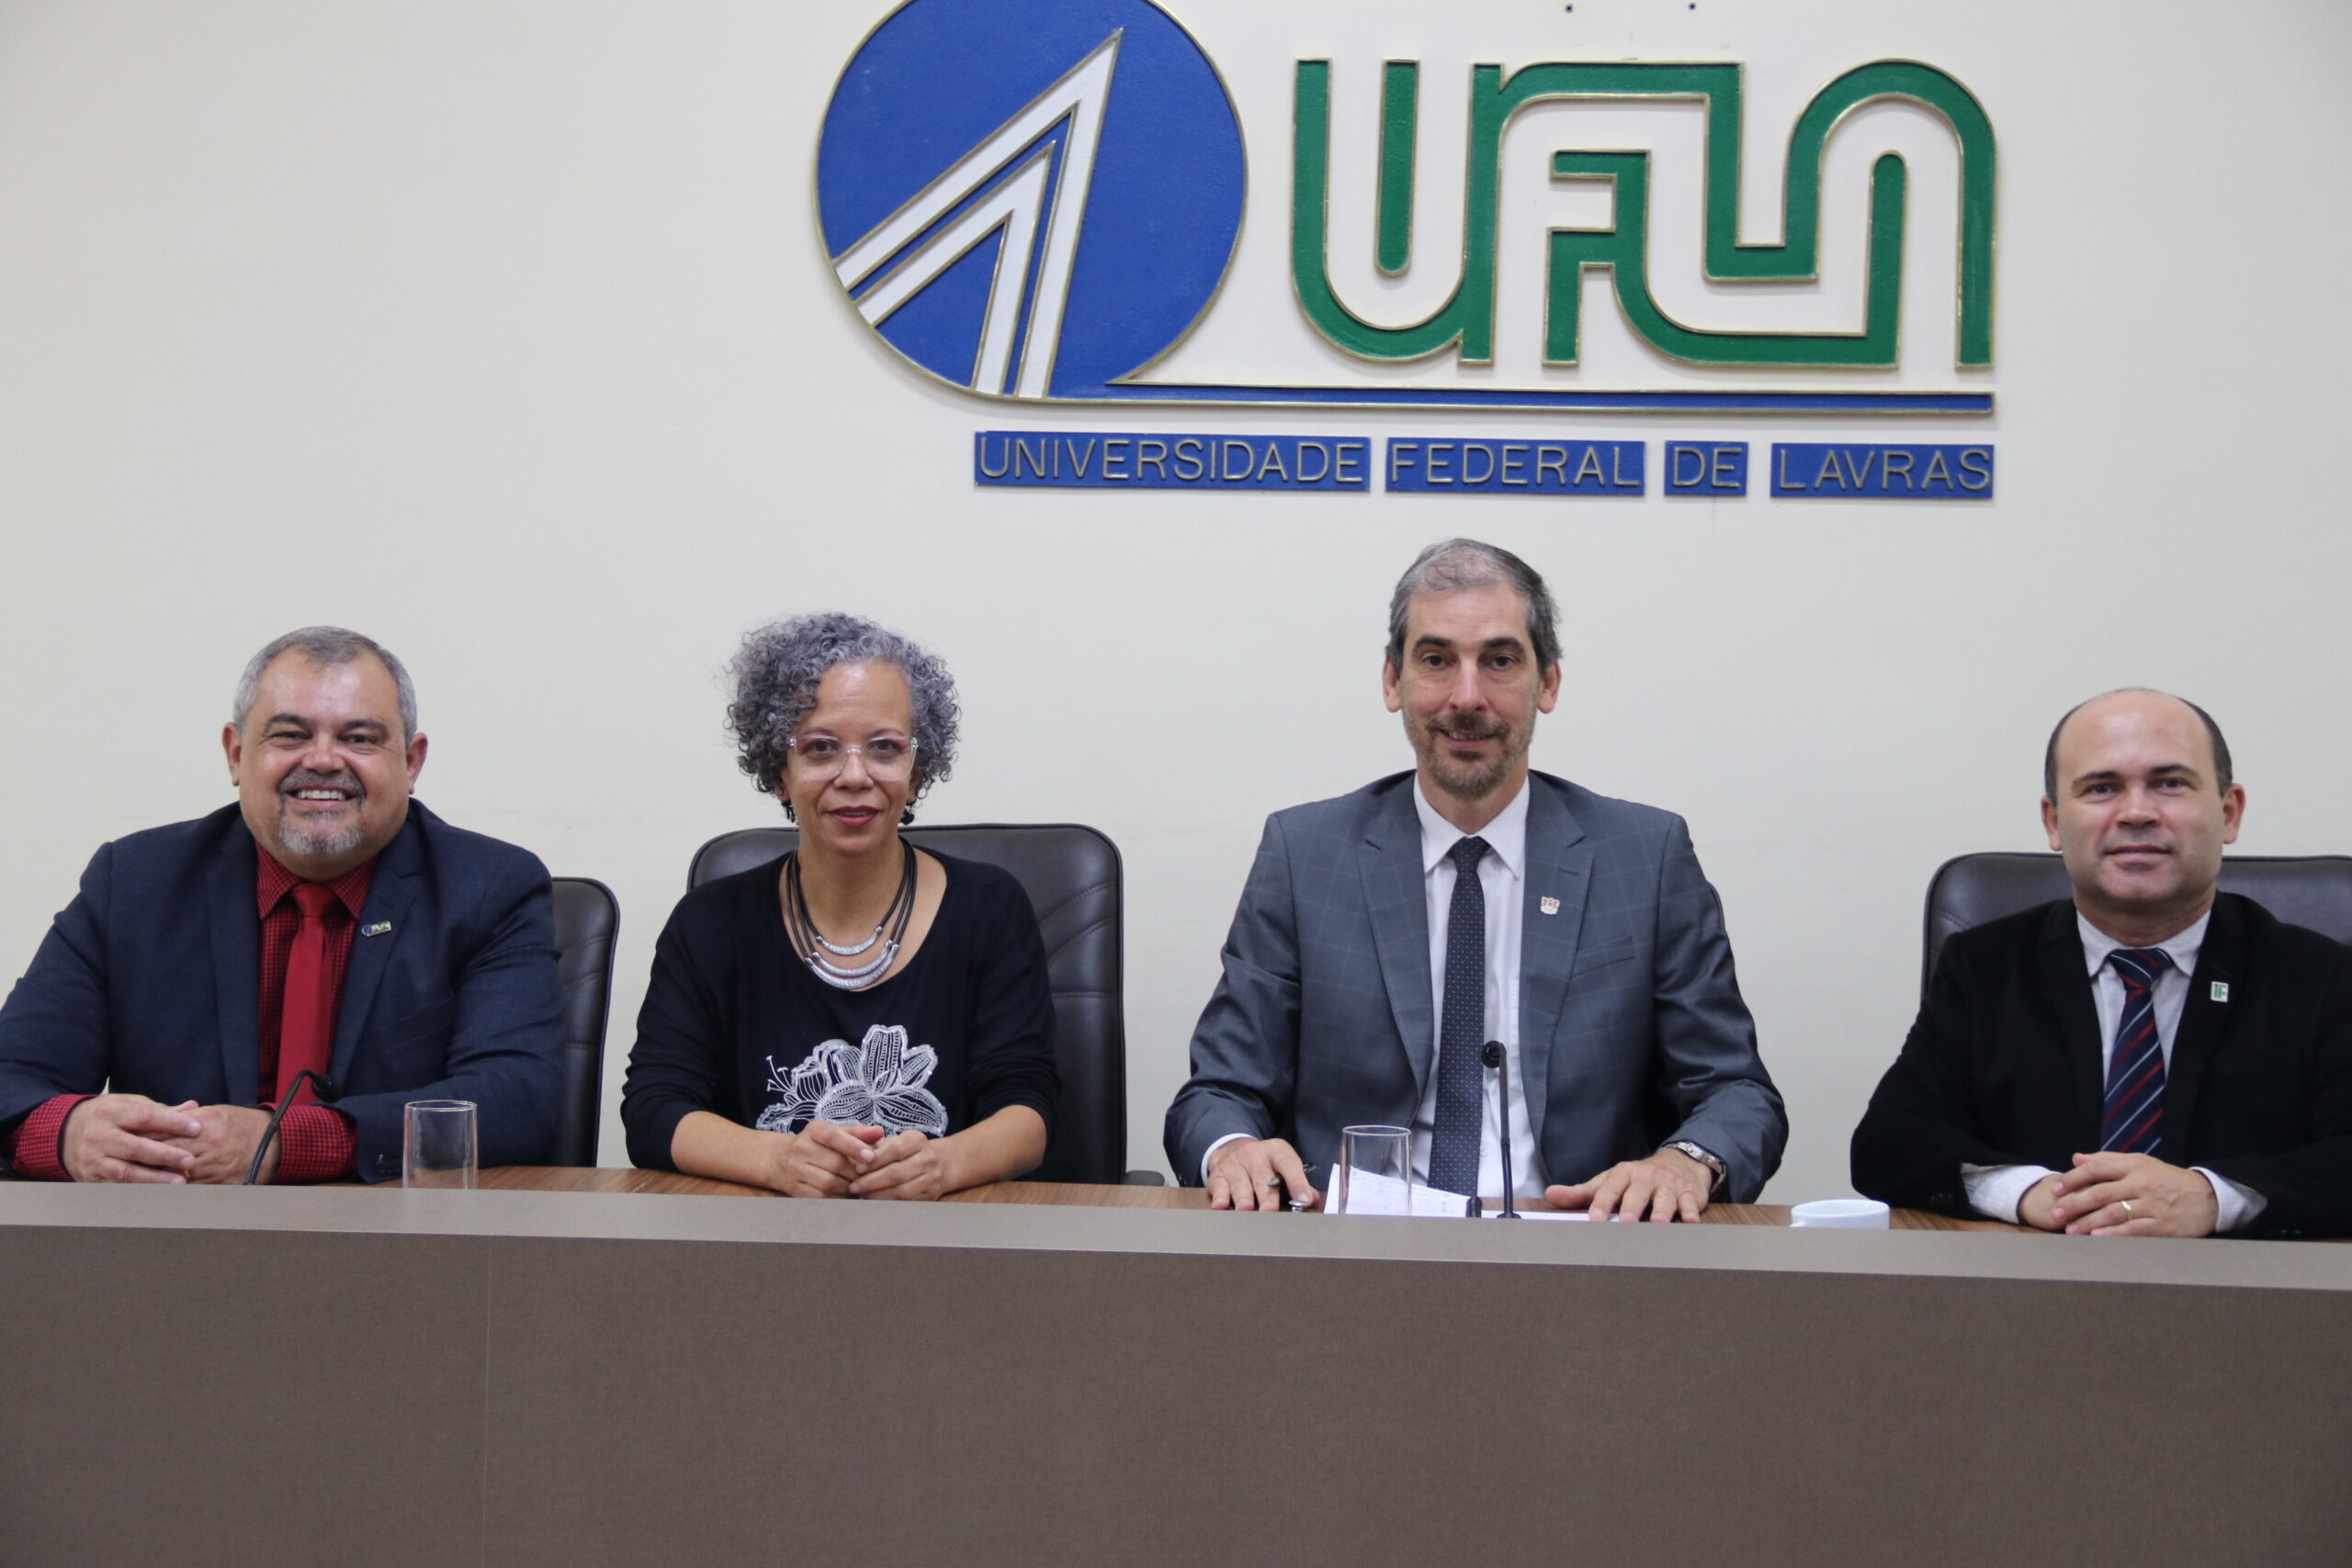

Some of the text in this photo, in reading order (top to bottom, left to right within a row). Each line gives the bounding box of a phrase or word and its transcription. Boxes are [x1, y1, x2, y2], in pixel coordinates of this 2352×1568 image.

[979, 437, 1991, 491] UNIVERSIDADE FEDERAL DE LAVRAS
